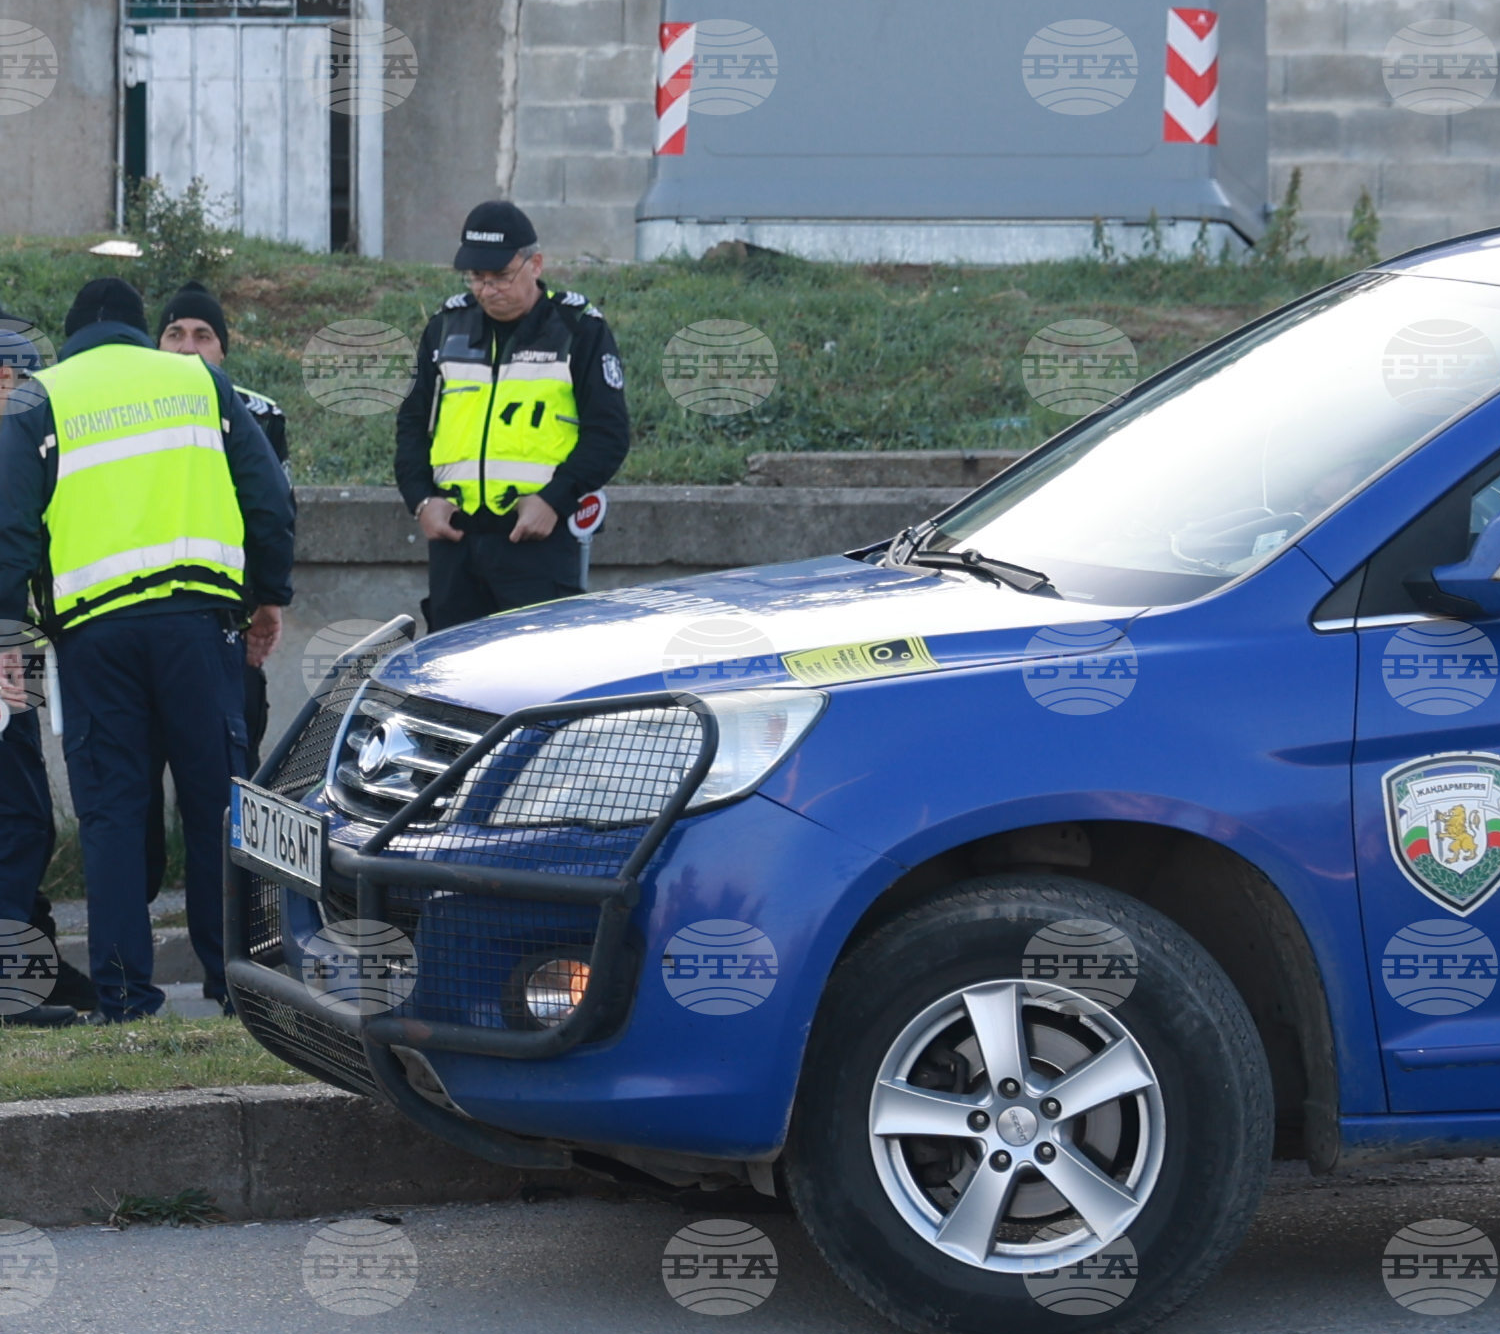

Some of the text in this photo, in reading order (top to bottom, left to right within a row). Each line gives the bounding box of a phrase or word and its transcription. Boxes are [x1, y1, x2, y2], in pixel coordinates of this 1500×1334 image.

[63, 394, 211, 442] ОХРАНИТЕЛНА ПОЛИЦИЯ
[1415, 782, 1487, 798] ЖАНДАРМЕРИЯ
